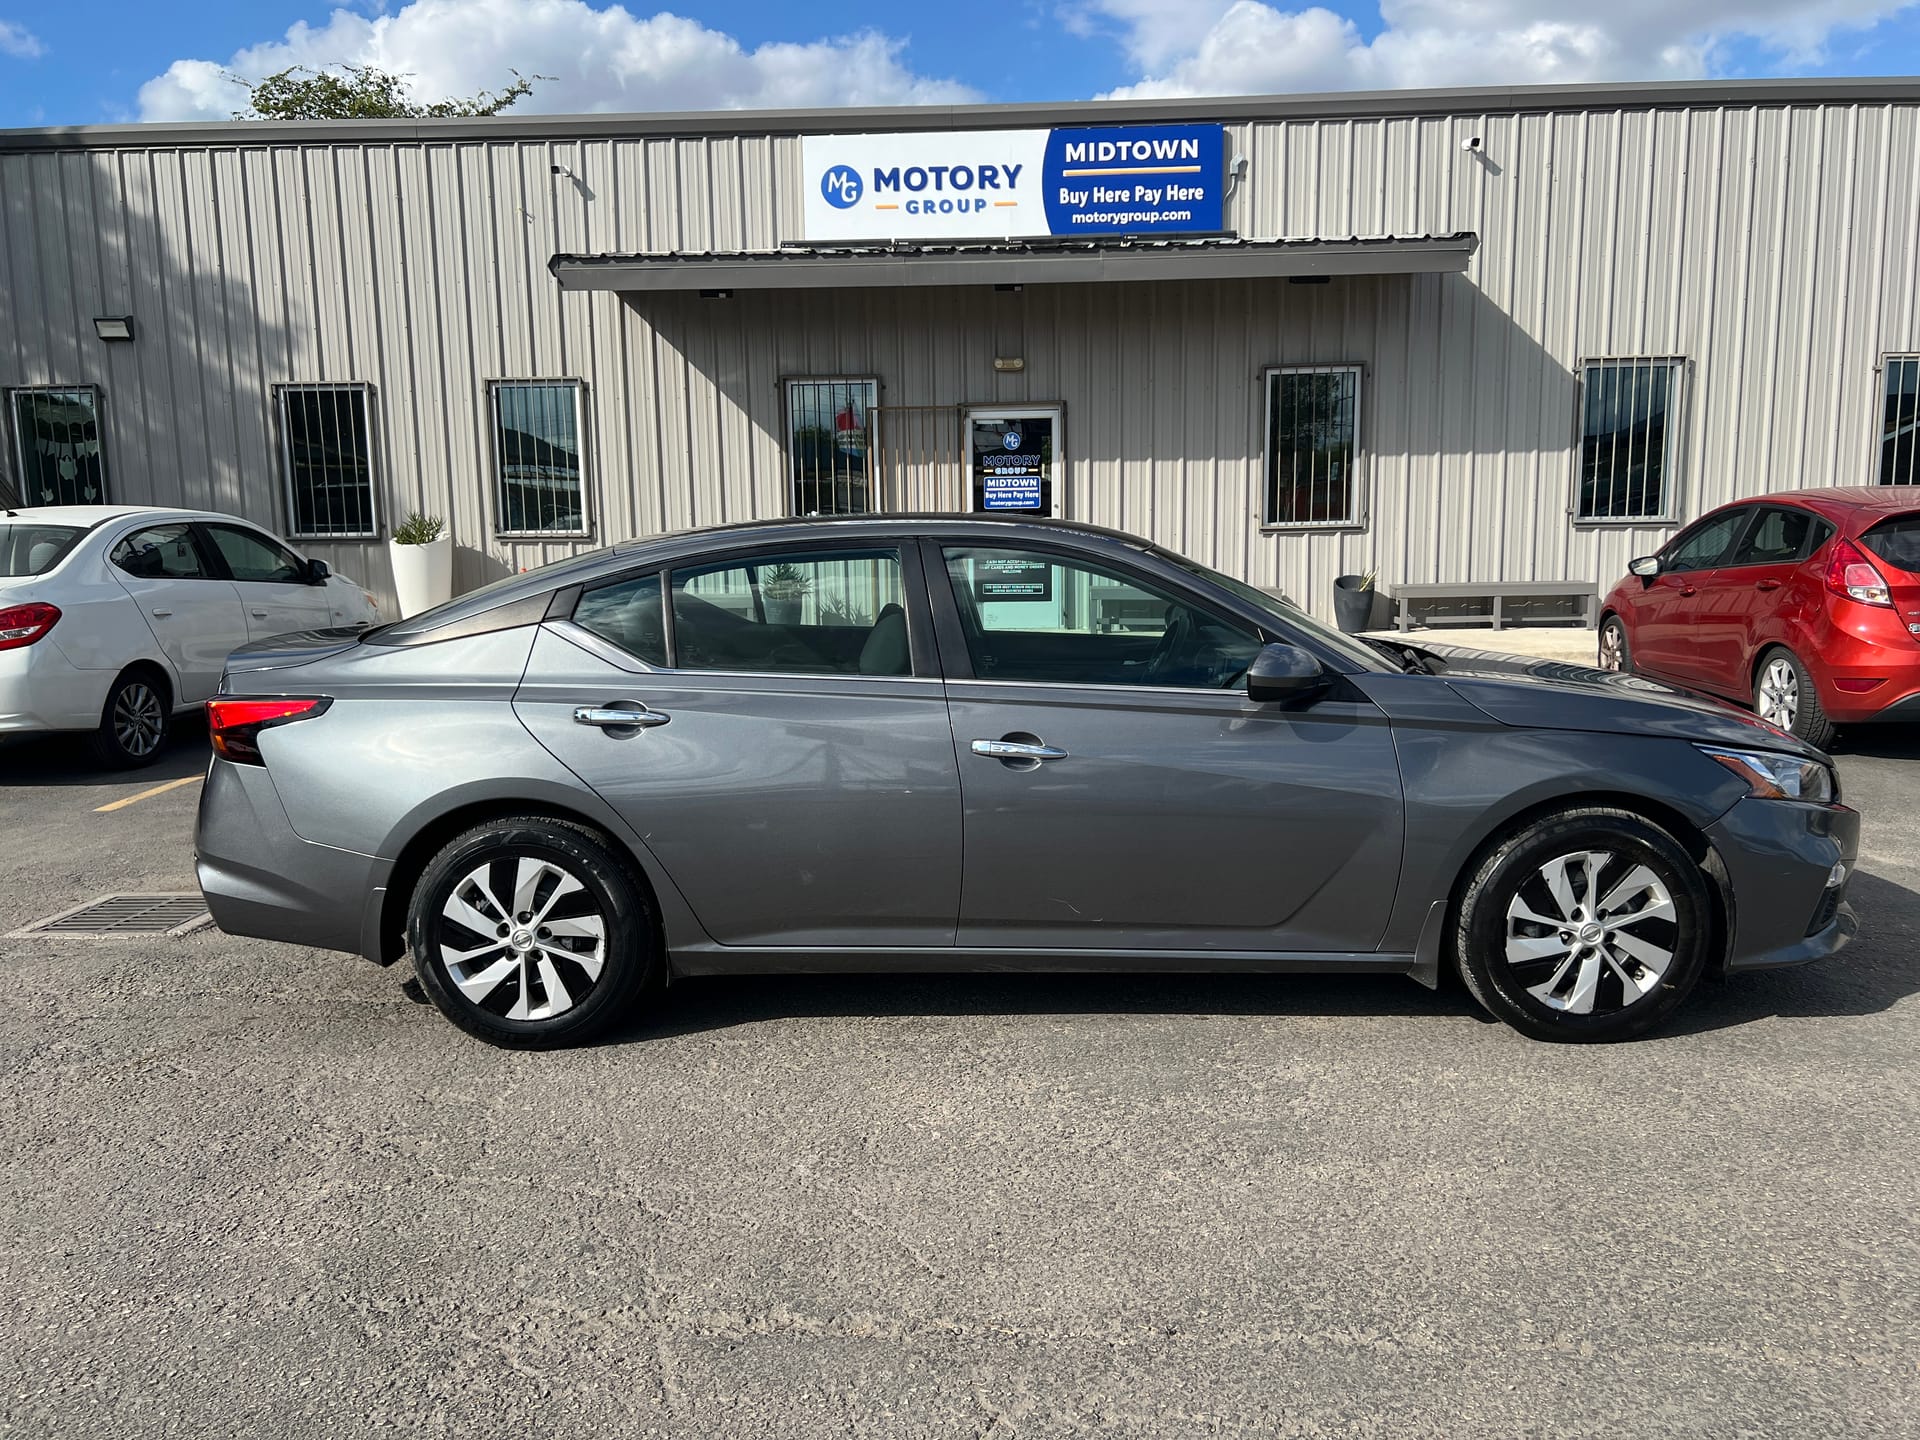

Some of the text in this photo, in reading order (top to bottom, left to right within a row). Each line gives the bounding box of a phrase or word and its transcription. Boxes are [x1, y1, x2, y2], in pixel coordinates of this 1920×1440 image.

[1065, 138, 1199, 163] MIDTOWN
[828, 171, 857, 203] MG
[873, 164, 1023, 193] MOTORY
[1059, 184, 1204, 209] Buy Here Pay Here
[905, 198, 988, 215] GROUP
[1072, 210, 1191, 225] motorygroup.com
[983, 455, 1040, 466] MOTORY
[995, 467, 1027, 475] GROUP
[987, 479, 1037, 487] MIDTOWN
